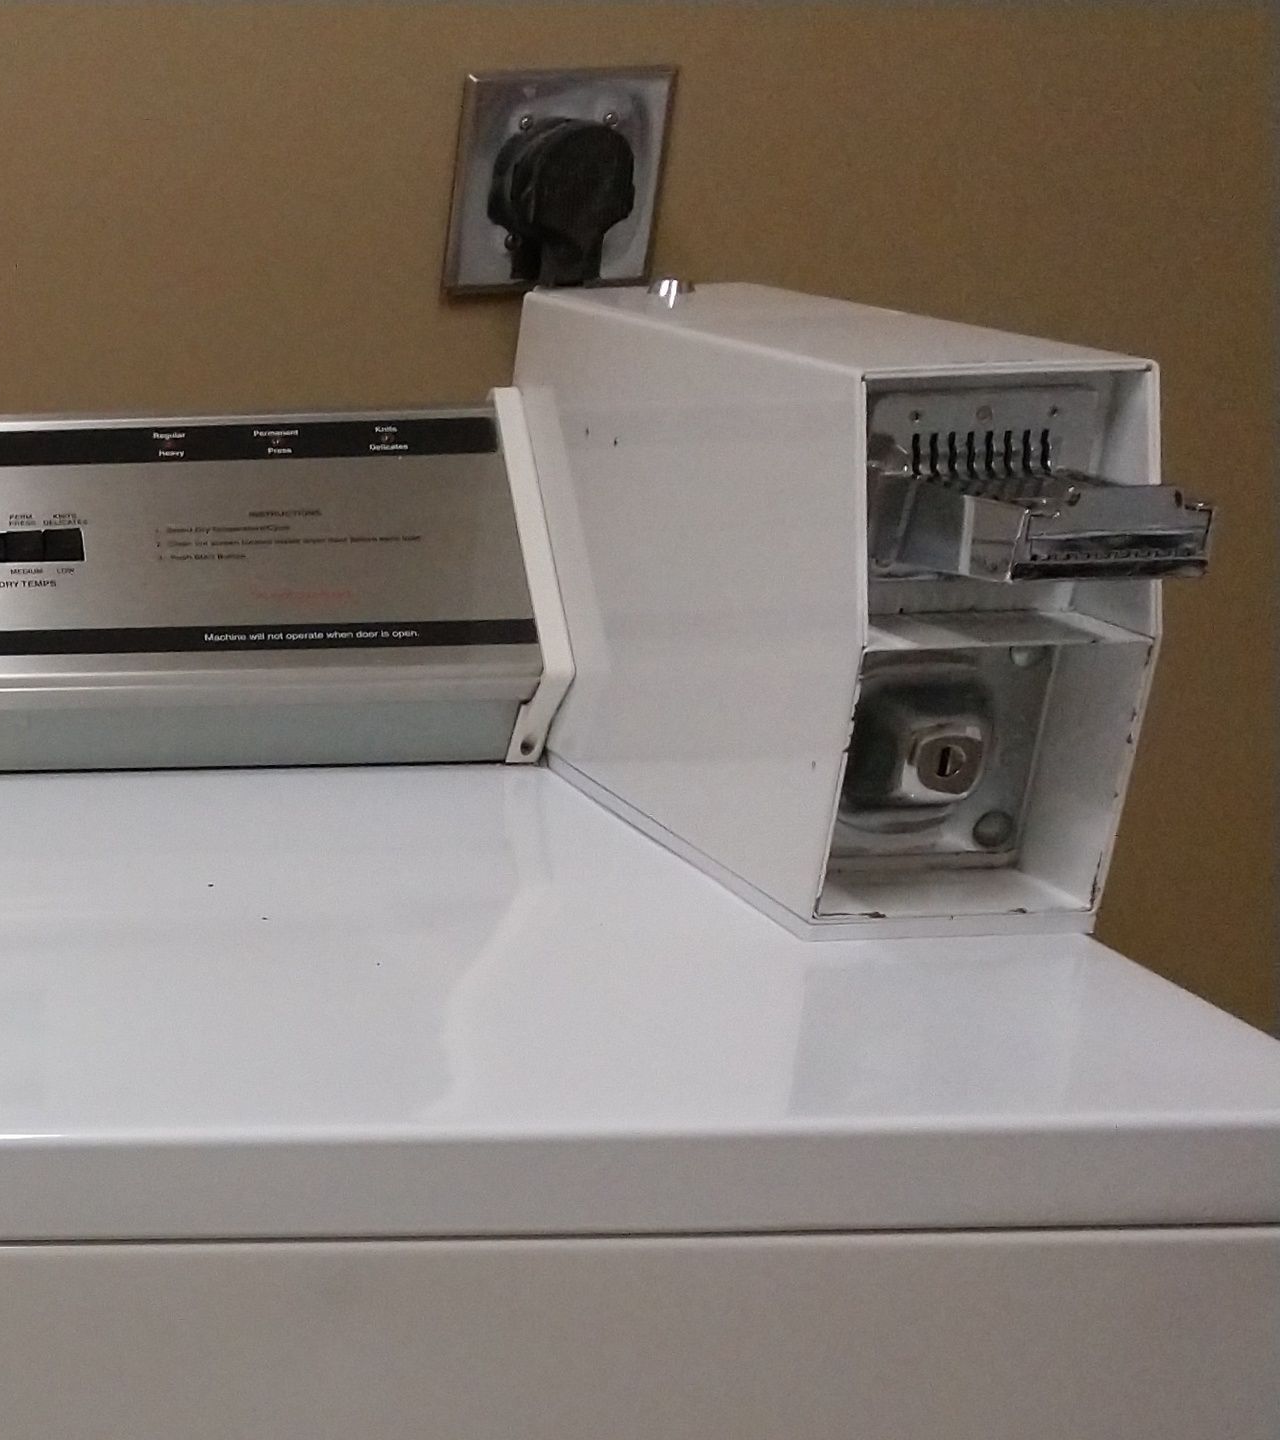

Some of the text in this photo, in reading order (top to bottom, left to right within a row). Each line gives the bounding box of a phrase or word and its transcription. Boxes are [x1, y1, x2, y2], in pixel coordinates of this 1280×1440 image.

[253, 429, 299, 437] Permanent
[204, 630, 419, 641] Machine will not operate when door is open.
